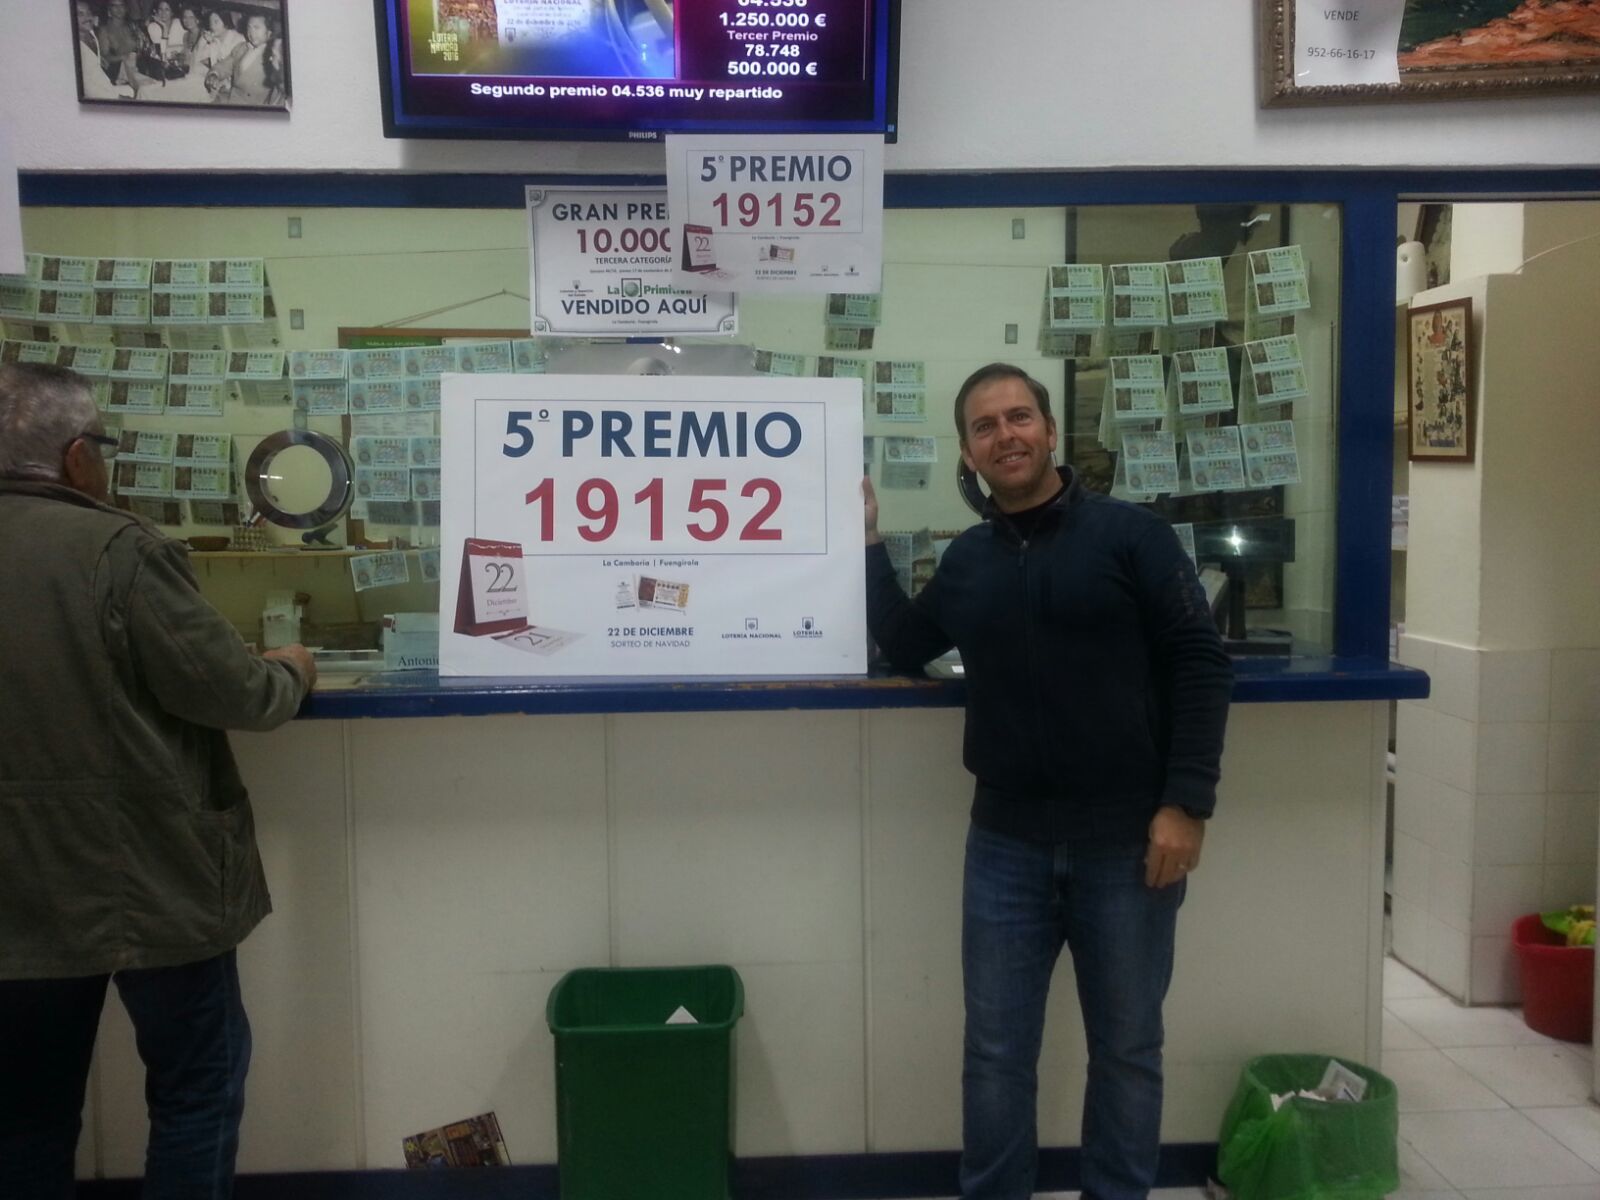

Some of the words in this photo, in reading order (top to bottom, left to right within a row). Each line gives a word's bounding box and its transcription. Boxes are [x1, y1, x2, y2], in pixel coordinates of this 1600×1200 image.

[719, 12, 810, 27] 1.250.000
[814, 13, 827, 27] €
[1324, 10, 1360, 21] VENDE
[727, 30, 768, 41] Tercer
[772, 31, 819, 41] Premio
[745, 44, 800, 57] 78.748
[1307, 47, 1376, 60] 952-66-16-17
[727, 61, 801, 76] 500.000
[805, 63, 818, 76] €
[470, 83, 545, 97] Segundo
[549, 85, 608, 98] premio
[611, 85, 665, 98] 04.536
[668, 86, 704, 100] muy
[708, 86, 783, 100] repartido
[730, 155, 852, 182] PREMIO
[552, 203, 618, 222] GRAN
[627, 203, 671, 221] PRE
[713, 192, 841, 228] 19152
[595, 257, 628, 265] TERCERA
[607, 285, 620, 295] La
[561, 299, 650, 315] VENDIDO
[657, 295, 707, 315] AQUÍ
[562, 410, 802, 458] PREMIO
[525, 477, 783, 543] 19152
[485, 563, 518, 594] 22
[607, 628, 621, 636] 22
[624, 628, 637, 636] DE
[640, 628, 694, 636] DICIEMBRE
[611, 640, 641, 648] SORTEO
[398, 655, 439, 667] Antoni
